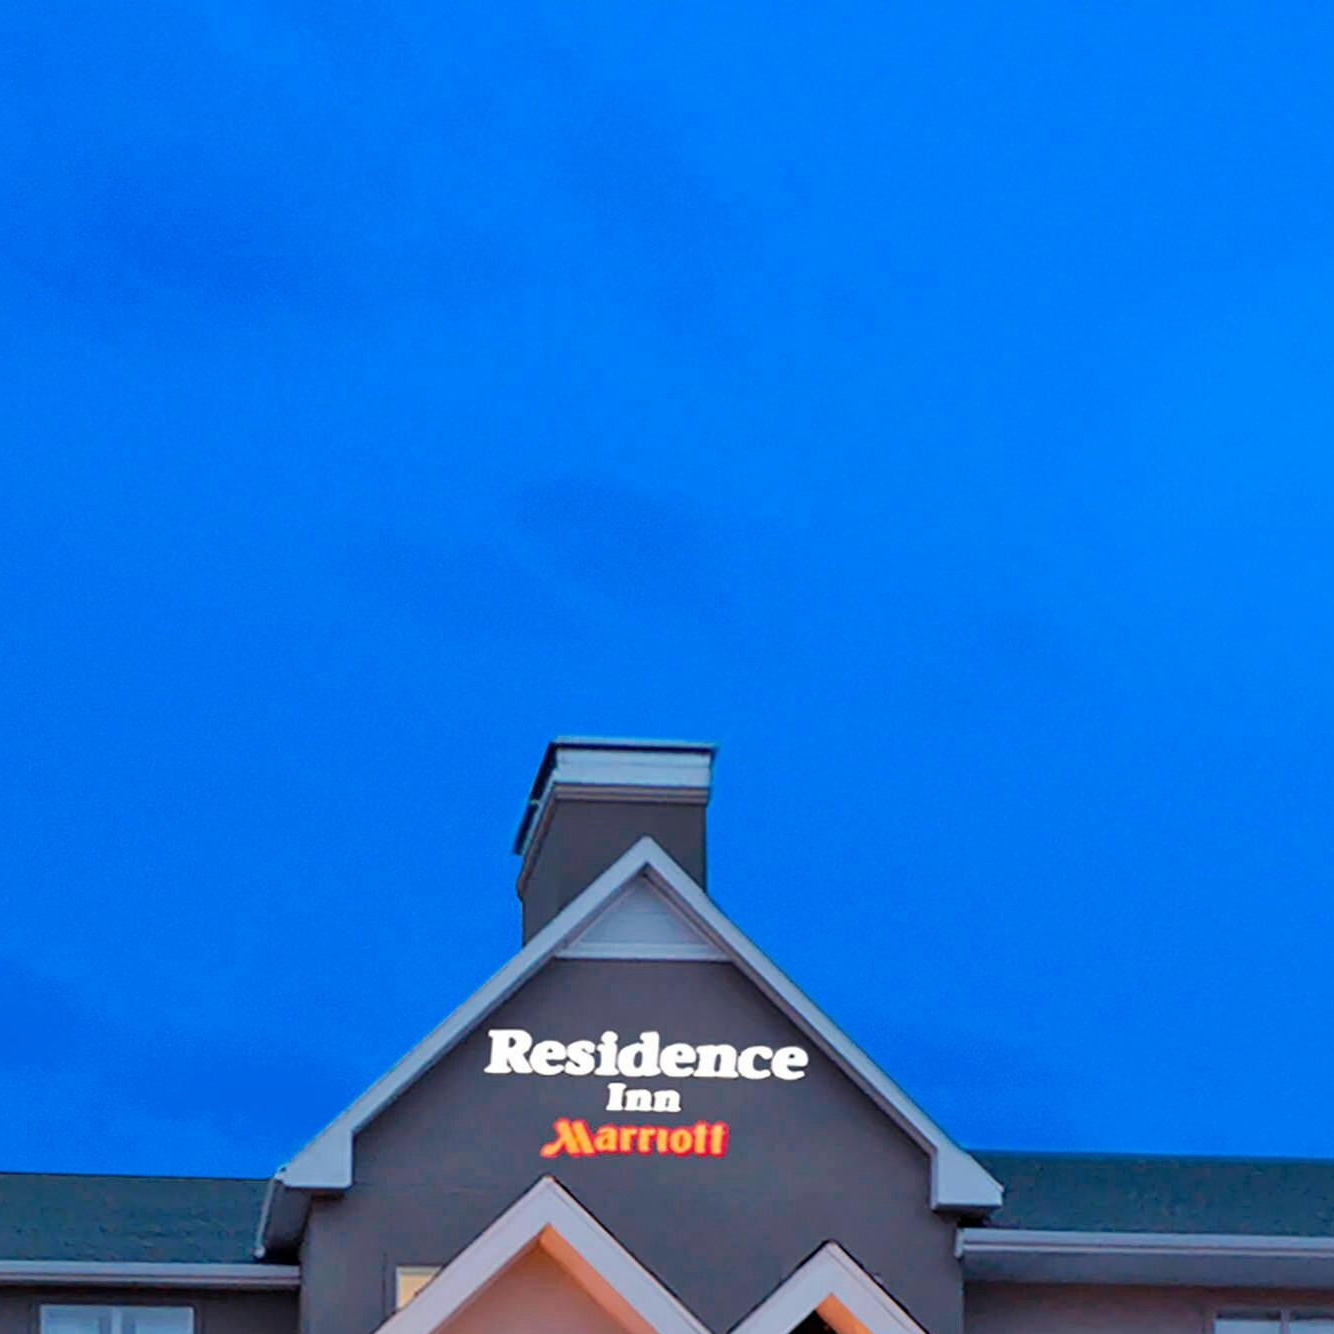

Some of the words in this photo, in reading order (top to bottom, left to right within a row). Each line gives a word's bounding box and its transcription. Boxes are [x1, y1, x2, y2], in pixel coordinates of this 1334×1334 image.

[483, 1029, 809, 1080] Residence
[605, 1083, 682, 1113] Inn
[540, 1117, 729, 1158] Marriott
